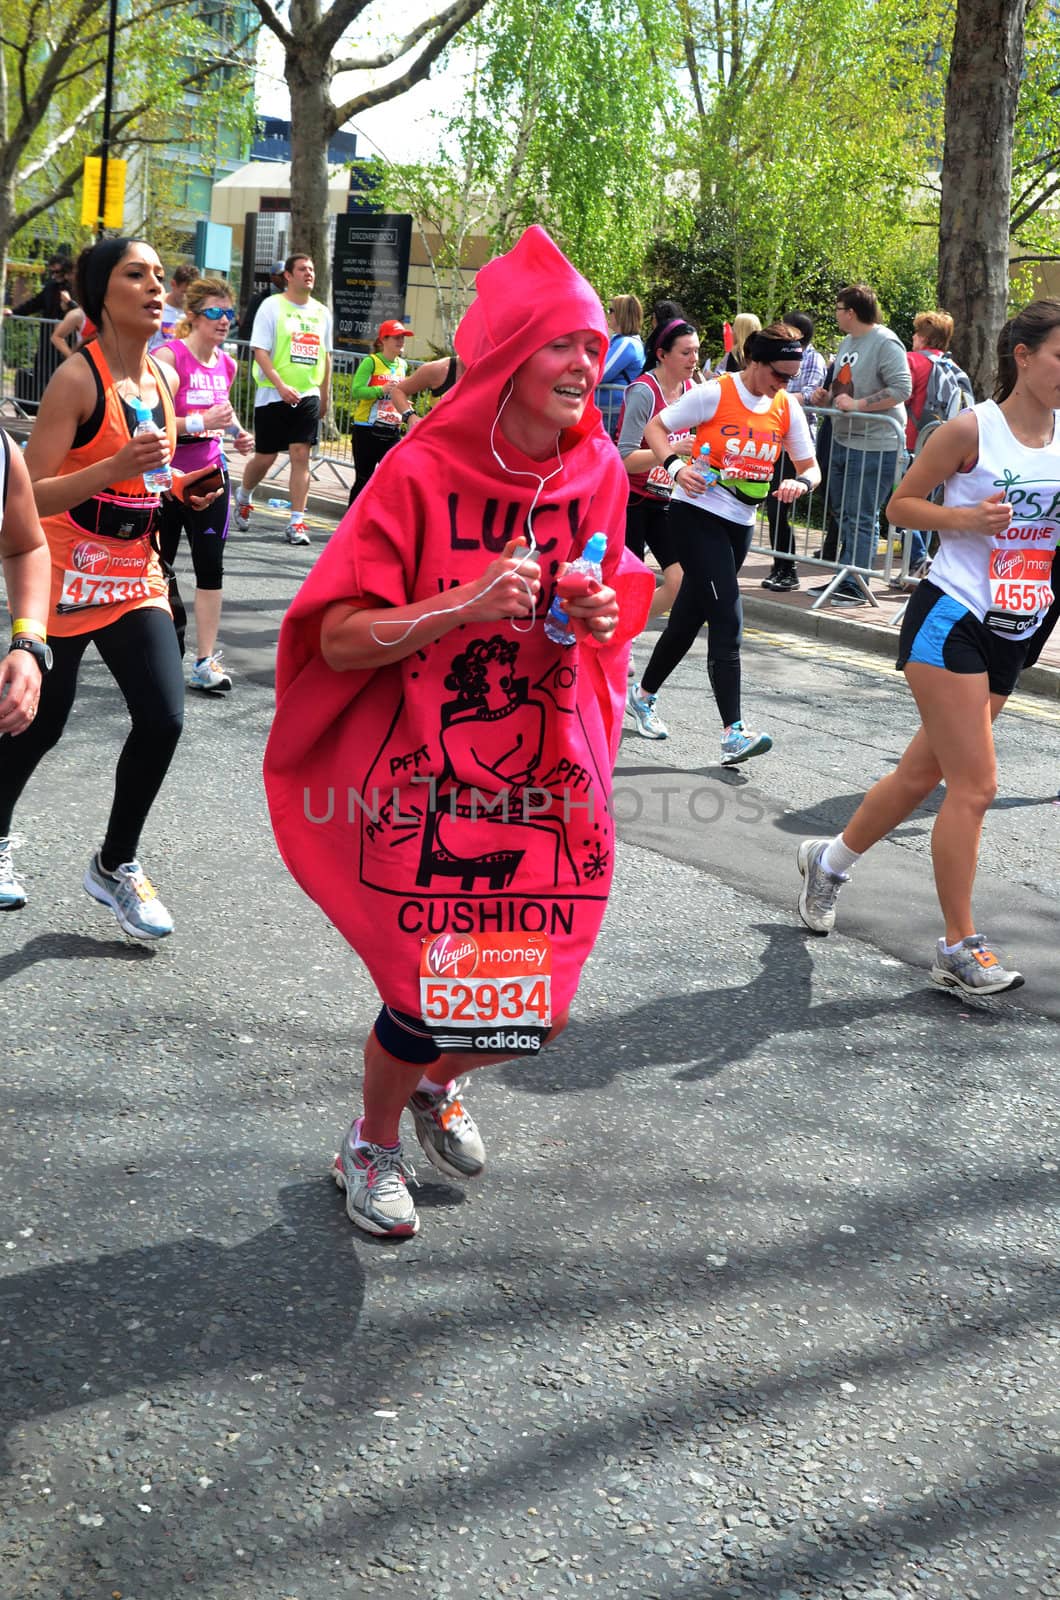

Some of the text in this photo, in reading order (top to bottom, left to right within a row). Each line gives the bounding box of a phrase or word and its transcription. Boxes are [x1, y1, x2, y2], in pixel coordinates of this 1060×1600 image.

[725, 437, 778, 463] SAM
[74, 544, 147, 573] Virgin money
[995, 550, 1024, 578] Virgin
[66, 577, 147, 604] 47338
[389, 744, 432, 777] PFFT
[556, 757, 594, 793] PFFT
[398, 900, 575, 935] CUSHION
[430, 935, 548, 976] Virgin money
[425, 980, 550, 1022] 52934
[474, 1031, 541, 1050] adidas
